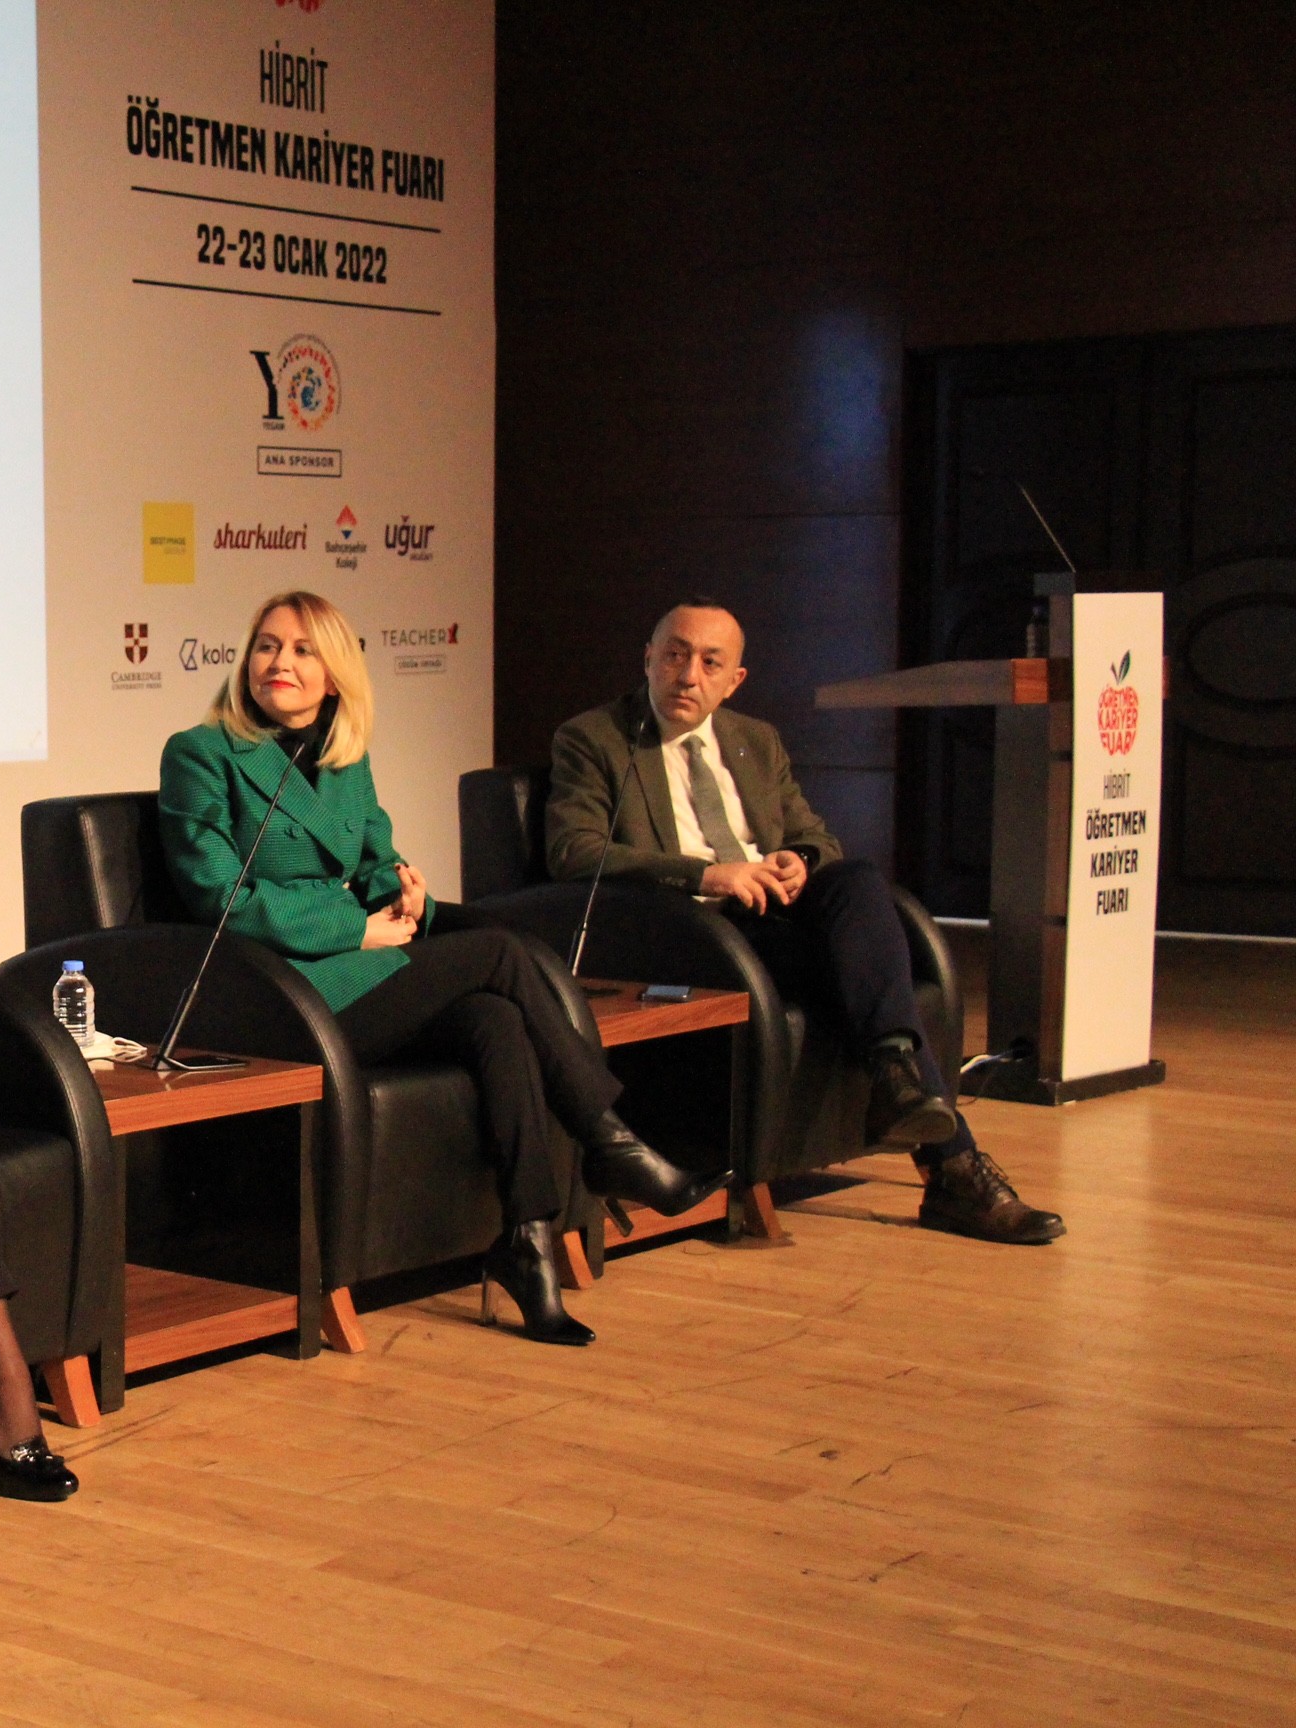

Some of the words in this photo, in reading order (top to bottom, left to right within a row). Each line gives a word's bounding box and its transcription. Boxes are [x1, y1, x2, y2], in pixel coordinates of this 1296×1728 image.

[260, 40, 328, 114] HİBRİT
[127, 94, 266, 175] ÖĞRETMEN
[274, 129, 374, 191] KARİYER
[381, 149, 444, 202] FUARI
[197, 223, 266, 271] 22-23
[273, 233, 328, 278] OCAK
[335, 242, 387, 284] 2022
[265, 455, 285, 465] ANA
[289, 456, 334, 467] SPONSOR
[213, 522, 308, 550] sharkuteri
[385, 515, 435, 556] uğur
[1086, 808, 1146, 841] ÖĞRETMEN
[1090, 845, 1138, 878] KARİYER
[1097, 888, 1129, 916] FUARI
